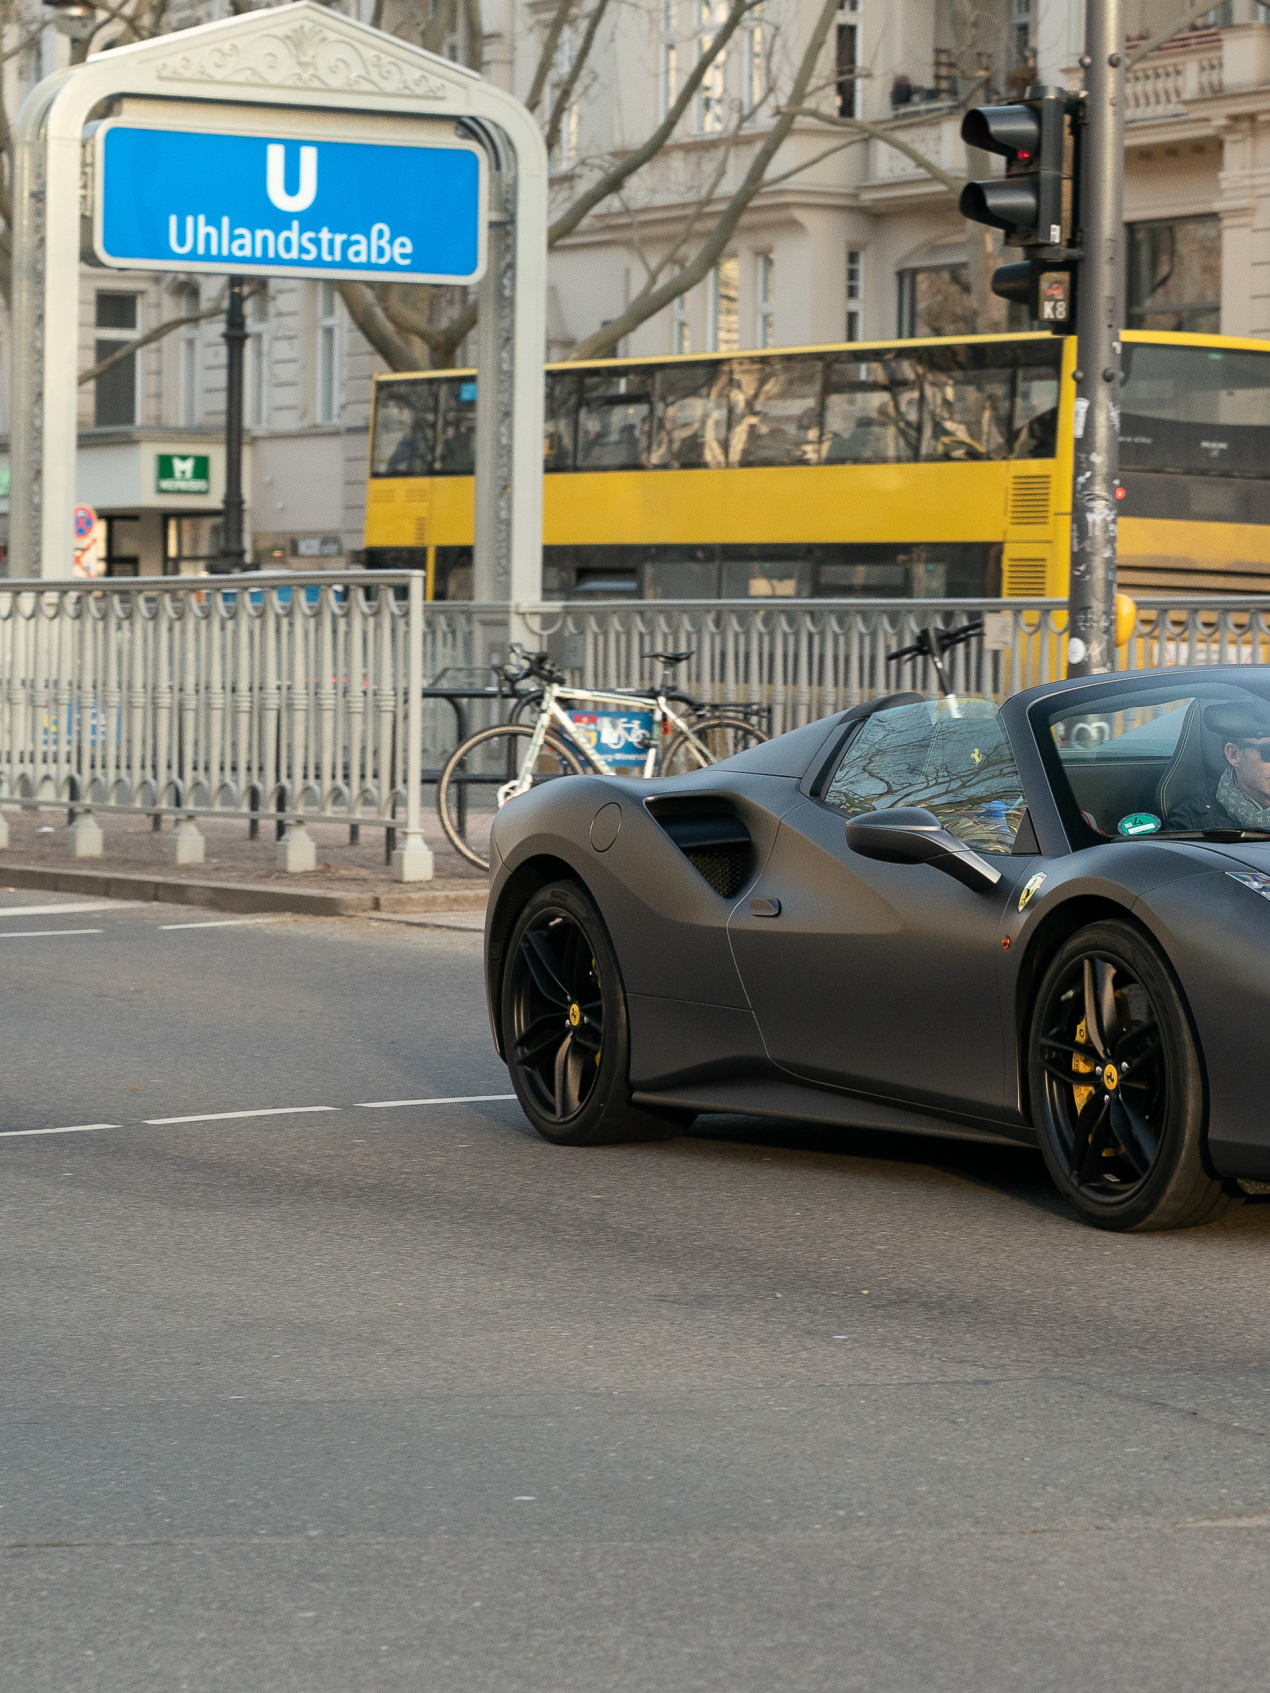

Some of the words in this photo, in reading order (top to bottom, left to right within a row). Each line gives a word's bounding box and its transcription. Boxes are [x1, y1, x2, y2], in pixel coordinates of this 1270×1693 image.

[266, 143, 319, 213] U
[168, 213, 414, 266] Uhlandstraße
[1043, 300, 1067, 319] K8
[1133, 816, 1144, 826] 4
